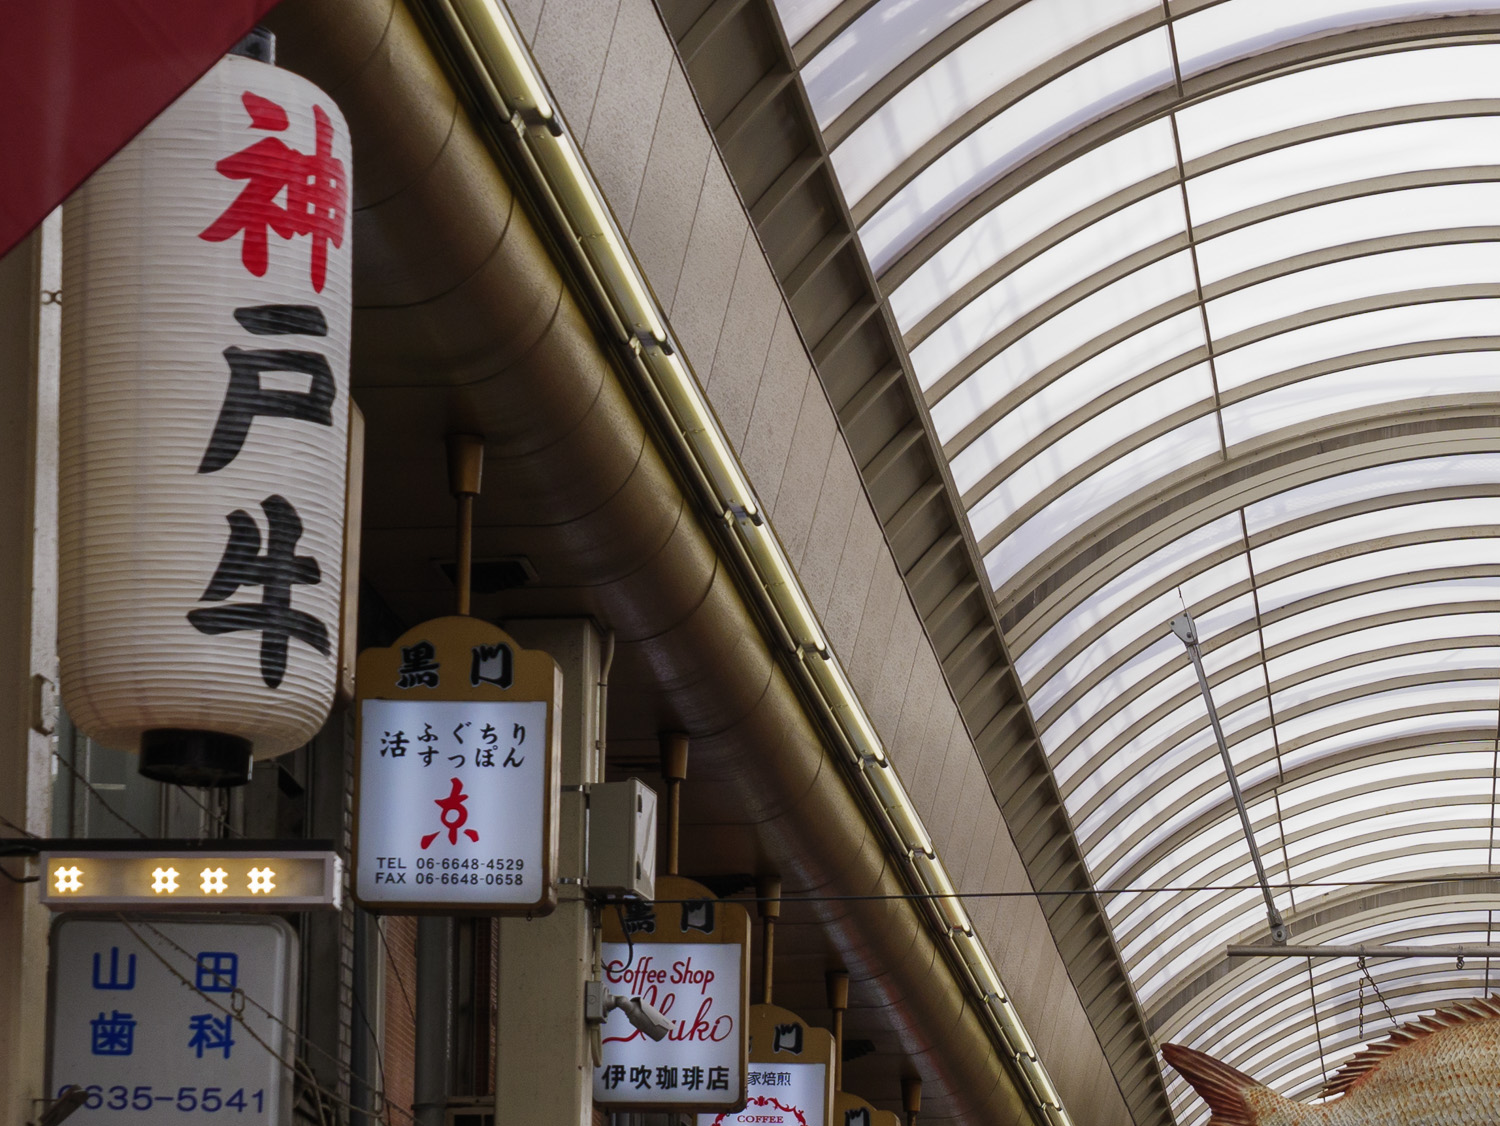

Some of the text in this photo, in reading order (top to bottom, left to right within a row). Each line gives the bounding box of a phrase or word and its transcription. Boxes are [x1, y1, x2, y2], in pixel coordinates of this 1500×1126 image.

[186, 91, 349, 689] 神戸牛
[396, 640, 513, 689] 黒門
[417, 722, 526, 746] ふぐちり
[417, 745, 525, 769] すっぽん
[376, 857, 524, 871] TEL 06-6648-4529
[375, 873, 523, 886] FAX 06-6648-0658
[92, 947, 238, 992] 山田
[606, 957, 714, 995] Coffee Shop
[90, 1010, 236, 1059] 歯科
[602, 1064, 729, 1091] 伊吹珈琲店
[737, 1115, 784, 1123] COFFEE
